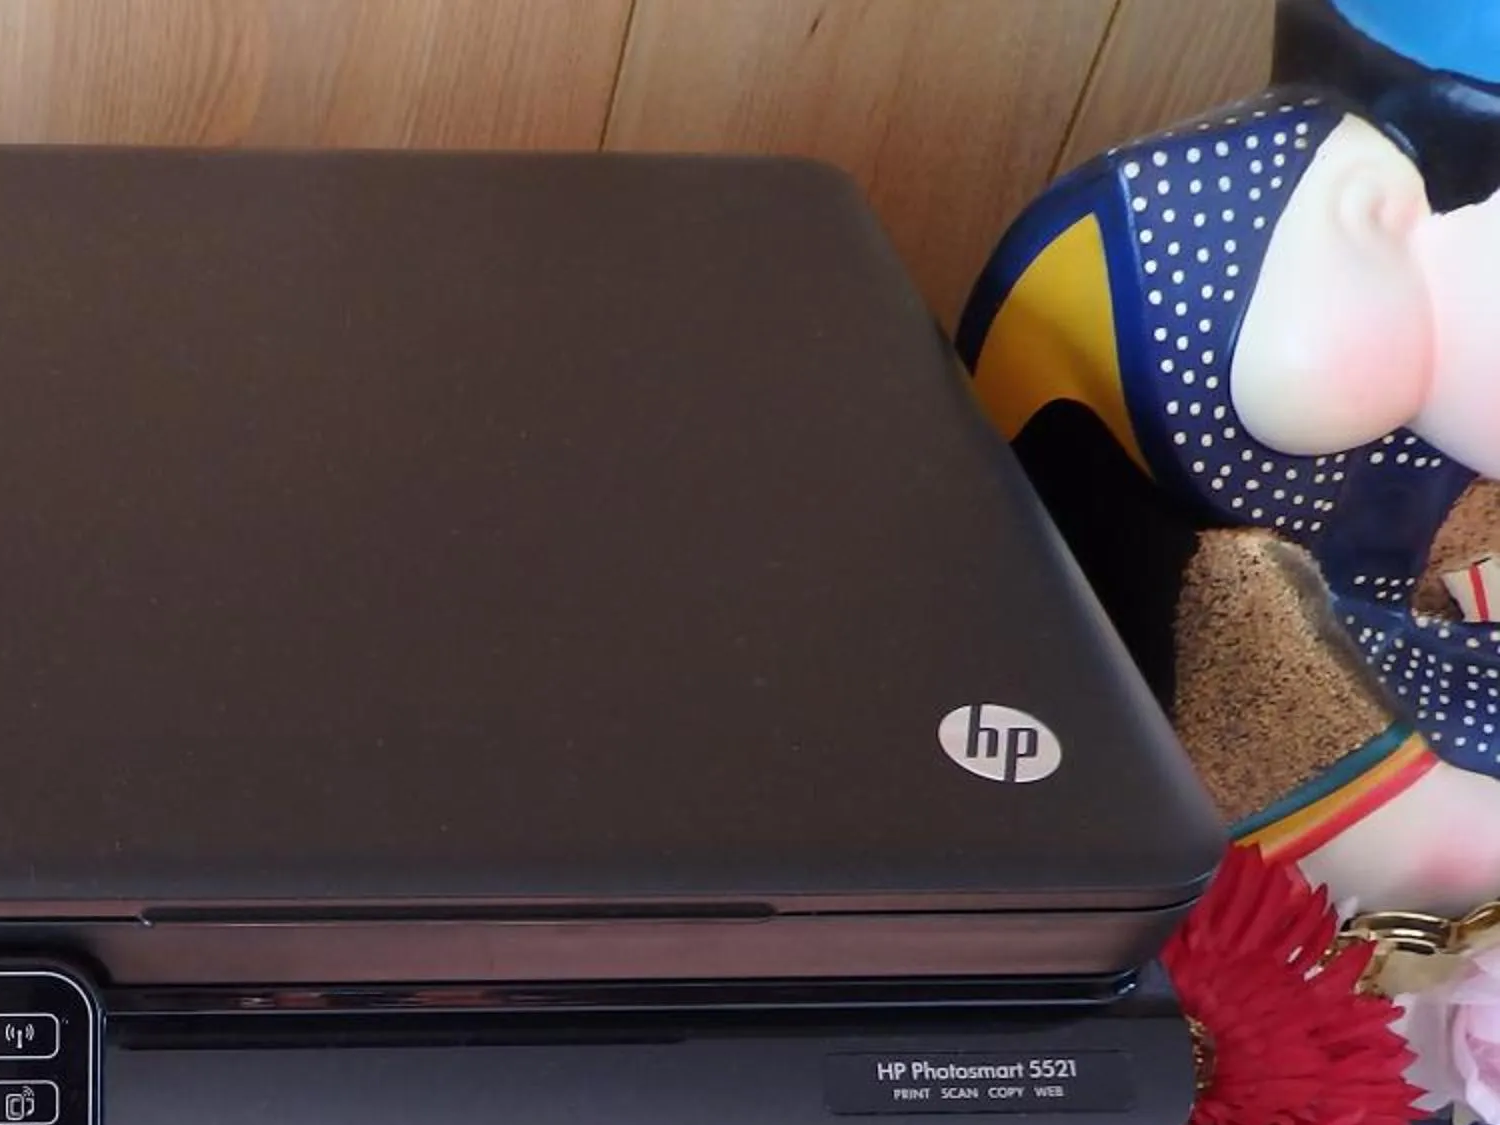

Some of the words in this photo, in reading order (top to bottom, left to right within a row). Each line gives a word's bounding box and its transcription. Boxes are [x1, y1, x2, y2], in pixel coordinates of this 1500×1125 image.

[965, 703, 1039, 783] hp
[876, 1062, 906, 1081] HP
[911, 1061, 1024, 1080] Photosmart
[1029, 1059, 1078, 1078] 5521
[893, 1087, 931, 1100] PRINT
[940, 1086, 979, 1100] SCAN
[987, 1086, 1026, 1099] COPY
[1033, 1085, 1065, 1098] WEB
